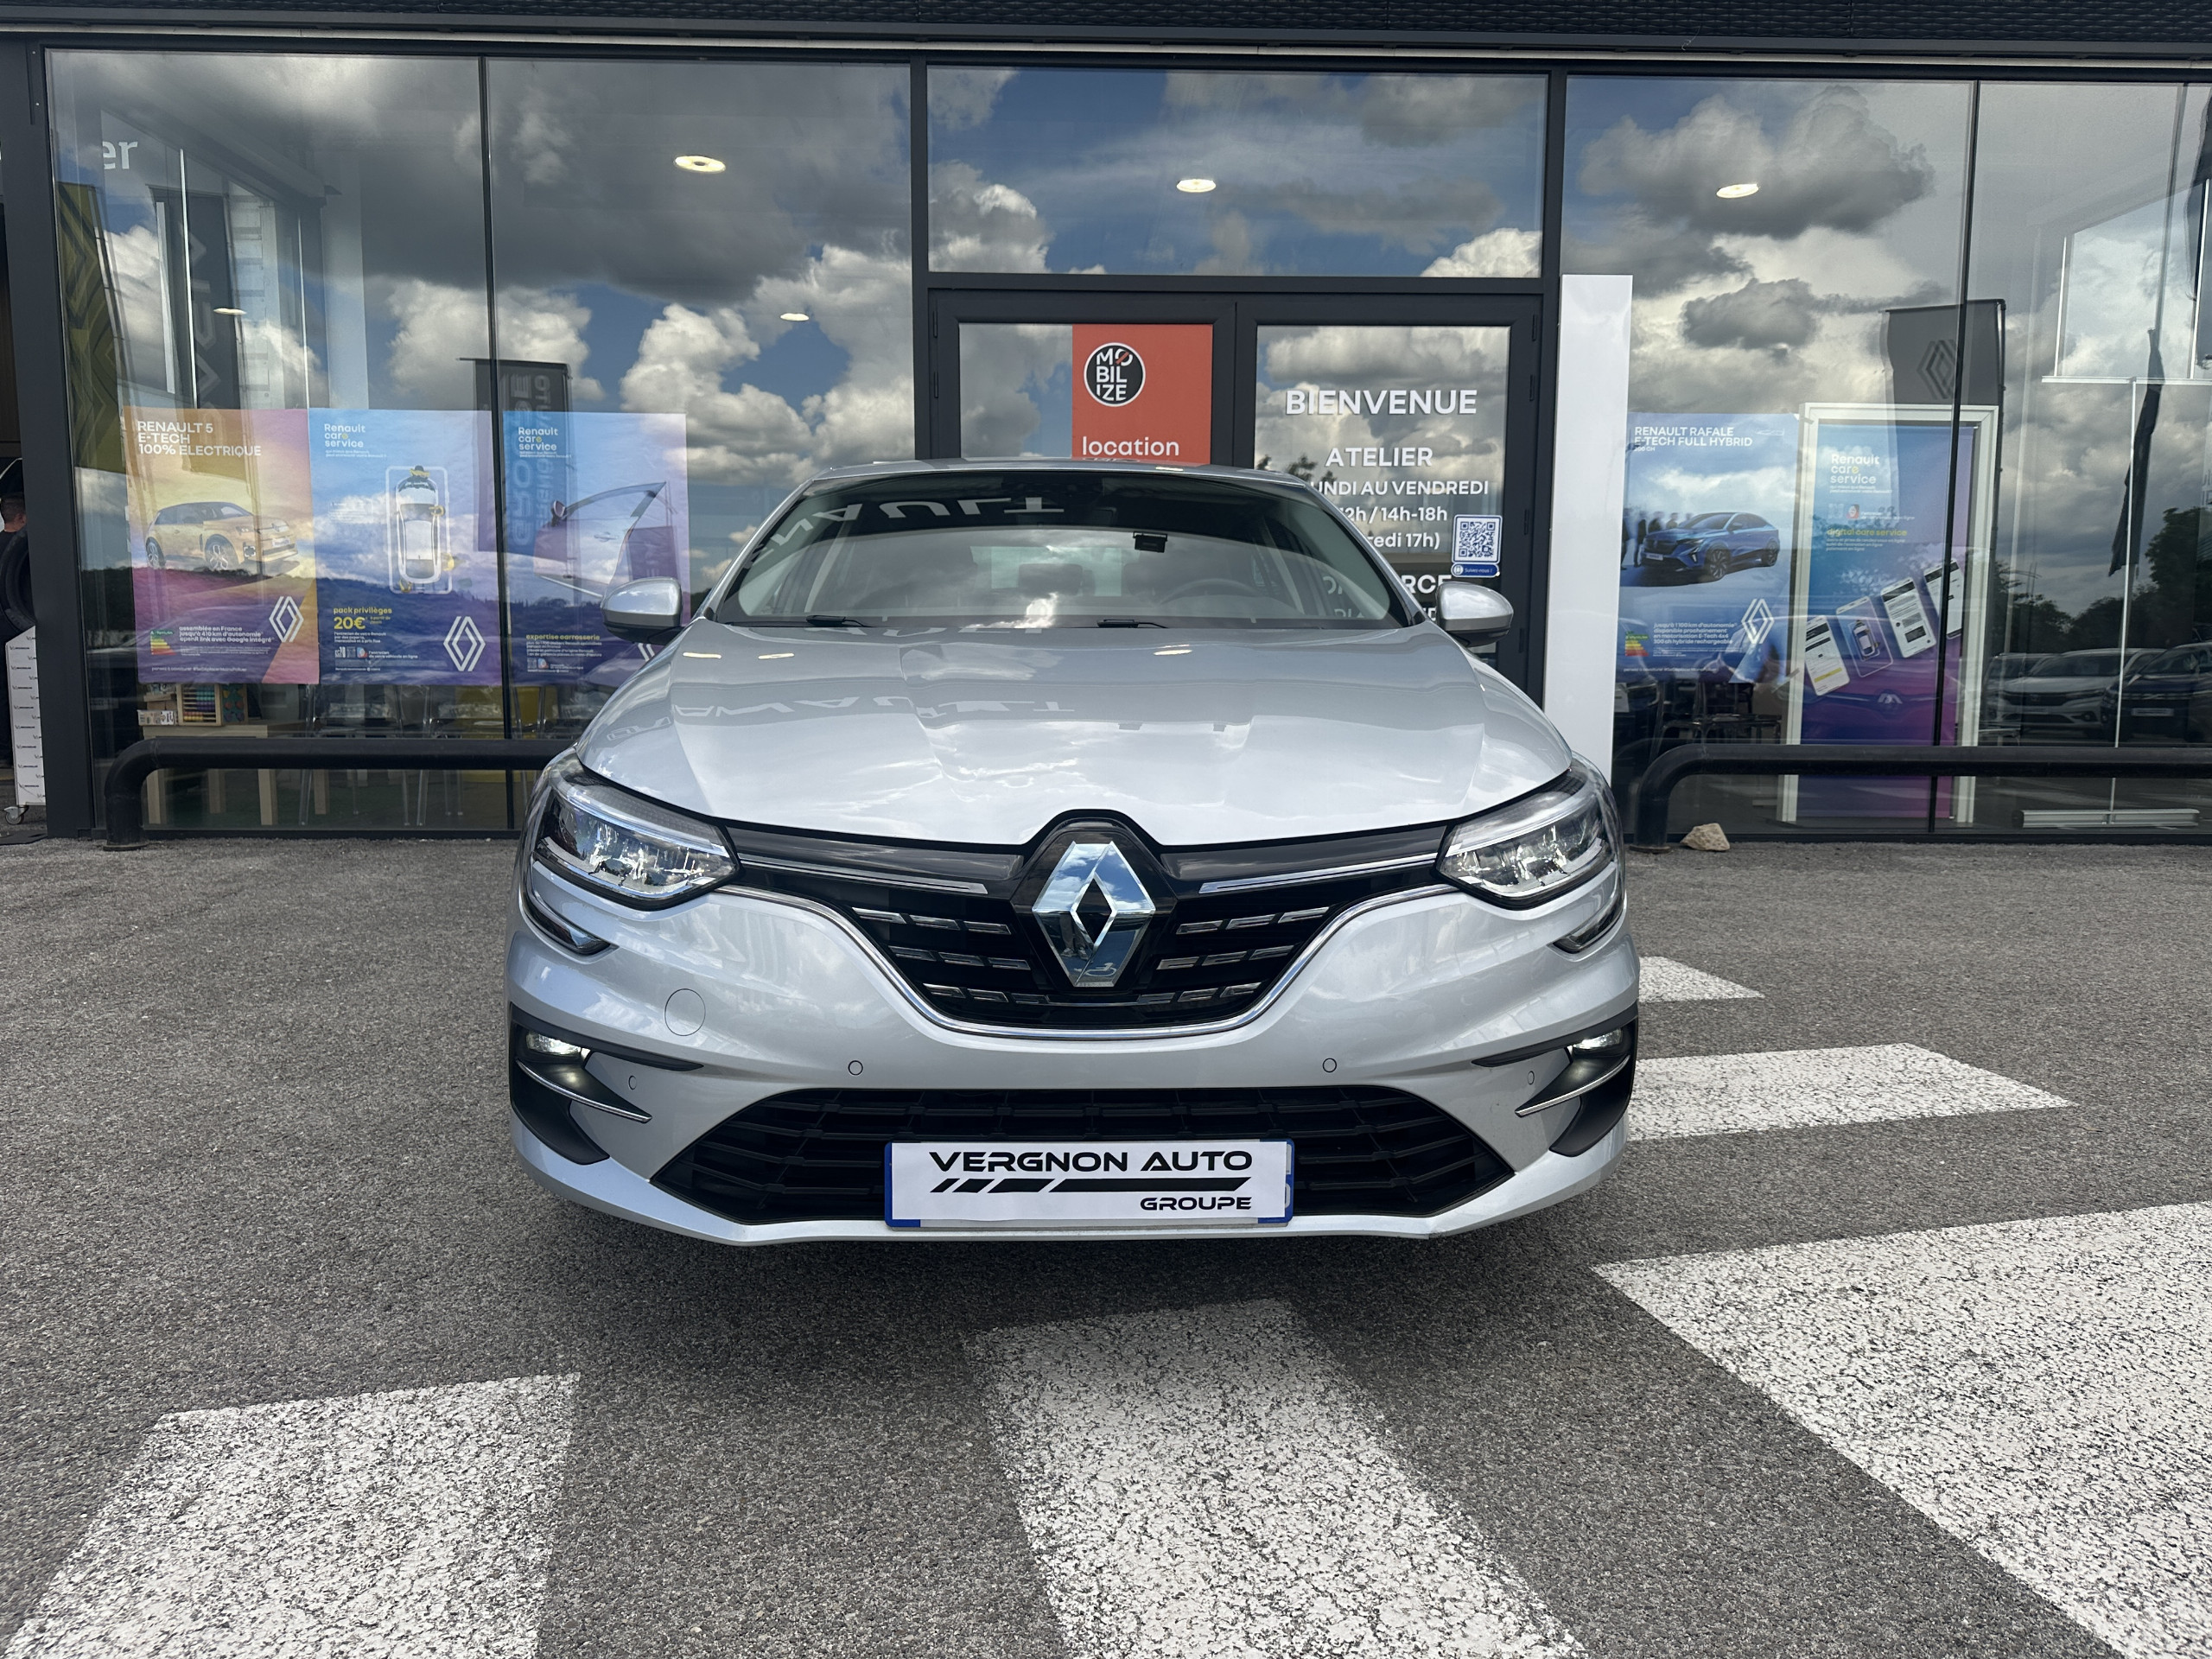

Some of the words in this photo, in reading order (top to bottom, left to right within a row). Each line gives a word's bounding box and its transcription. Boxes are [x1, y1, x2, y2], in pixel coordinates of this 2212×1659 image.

[1286, 390, 1478, 415] BIENVENUE
[137, 421, 203, 433] RENAULT
[206, 423, 213, 433] 5
[324, 423, 365, 433] Renault
[518, 427, 558, 435] Renault
[1634, 426, 1688, 436] RENAULT
[1690, 427, 1735, 436] RAFALE
[138, 432, 190, 444] E-TECH
[325, 439, 364, 448] service
[1634, 436, 1675, 446] E-TECH
[1678, 436, 1707, 447] FULL
[1709, 437, 1753, 447] HYBRID
[138, 443, 176, 454] 100%
[179, 445, 262, 457] ELECTRIQUE
[518, 442, 557, 451] service
[1083, 435, 1179, 456] location
[1325, 447, 1433, 467] ATELIER
[1831, 454, 1880, 465] Renault
[1831, 466, 1859, 474] care
[1830, 474, 1877, 484] service
[1361, 480, 1388, 495] AU
[1392, 480, 1489, 495] VENDREDI
[1339, 506, 1366, 521] 2h
[1381, 506, 1448, 521] 14h-18h
[1827, 528, 1855, 537] digital
[1405, 532, 1440, 550] 17h)
[353, 607, 392, 615] privilèges
[334, 616, 365, 630] 20€
[929, 1151, 1128, 1172] VERGNON
[1140, 1150, 1253, 1172] AUTO
[1140, 1197, 1253, 1211] GROUPE
